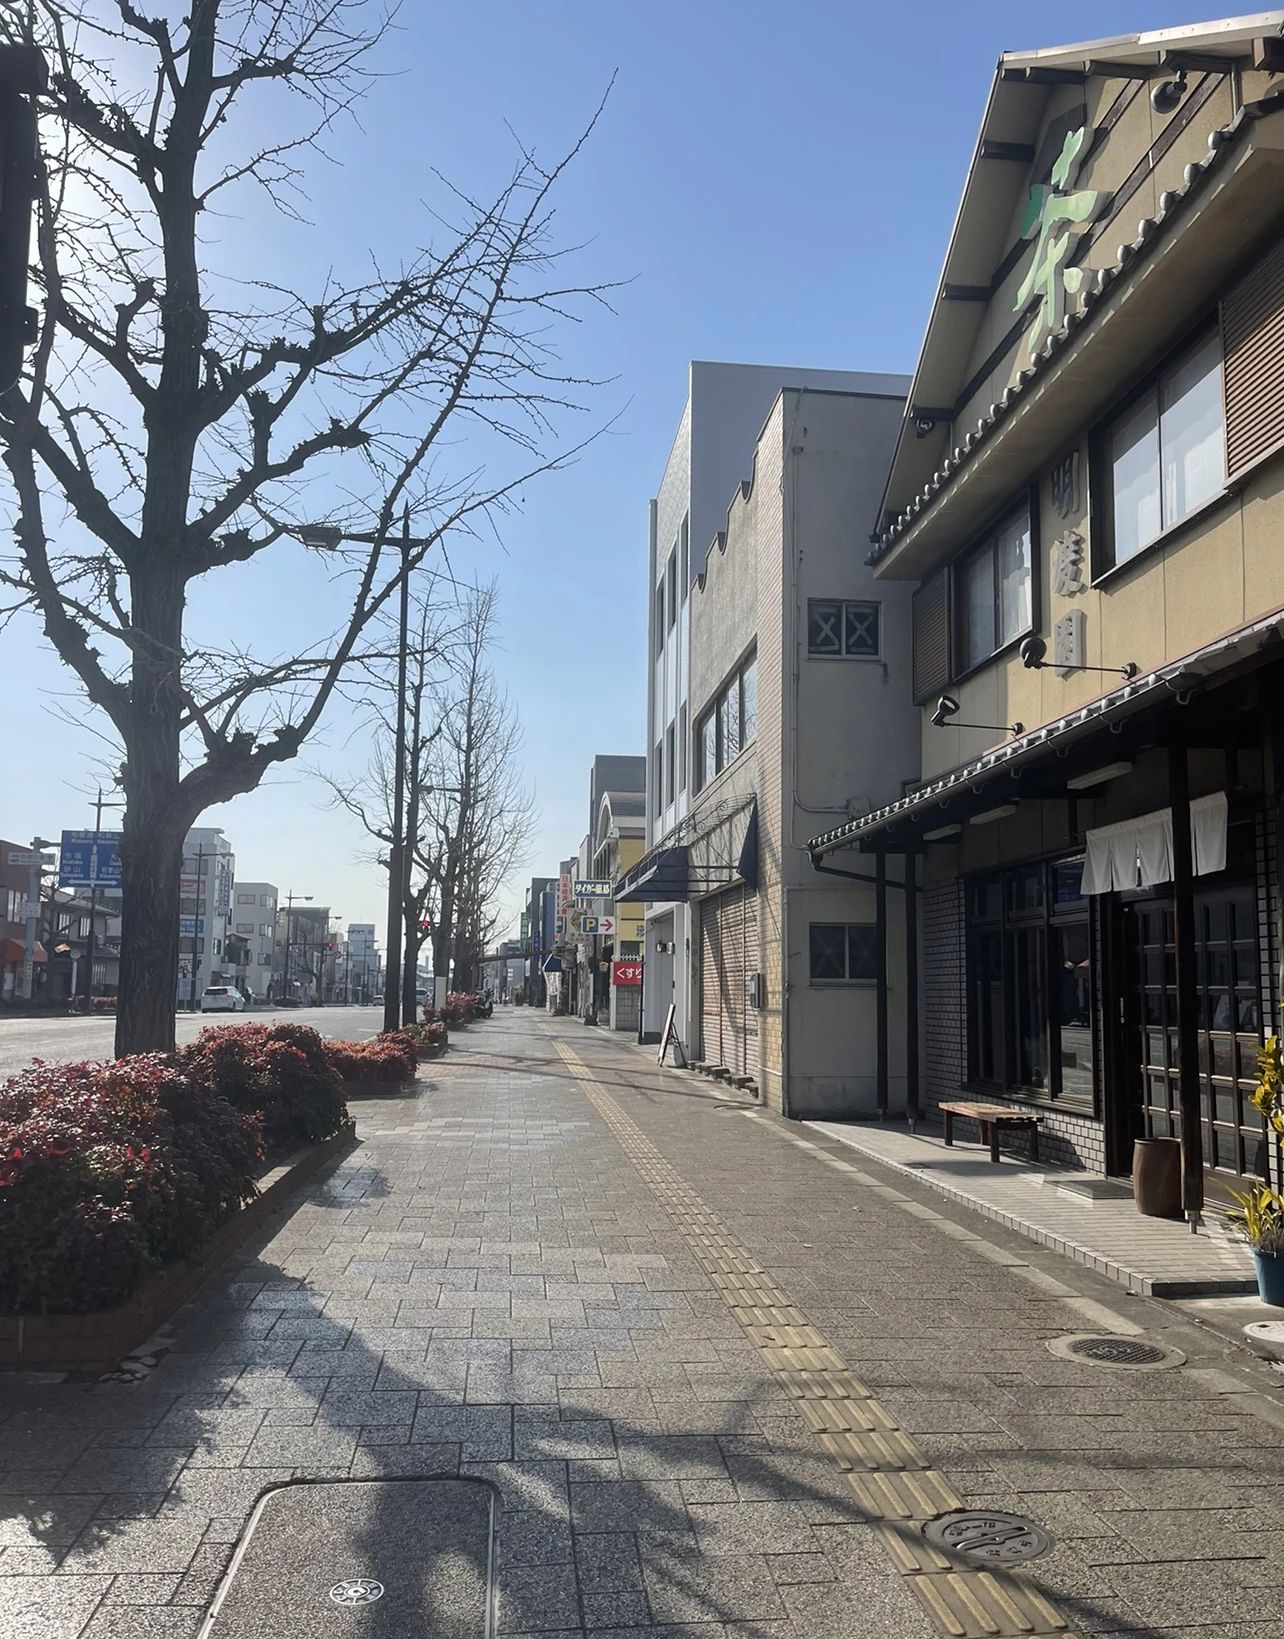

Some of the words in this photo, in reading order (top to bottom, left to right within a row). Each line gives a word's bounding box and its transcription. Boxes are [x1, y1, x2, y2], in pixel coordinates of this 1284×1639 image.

[1013, 126, 1100, 353] 茶
[586, 918, 596, 931] P
[617, 967, 642, 979] くすり
